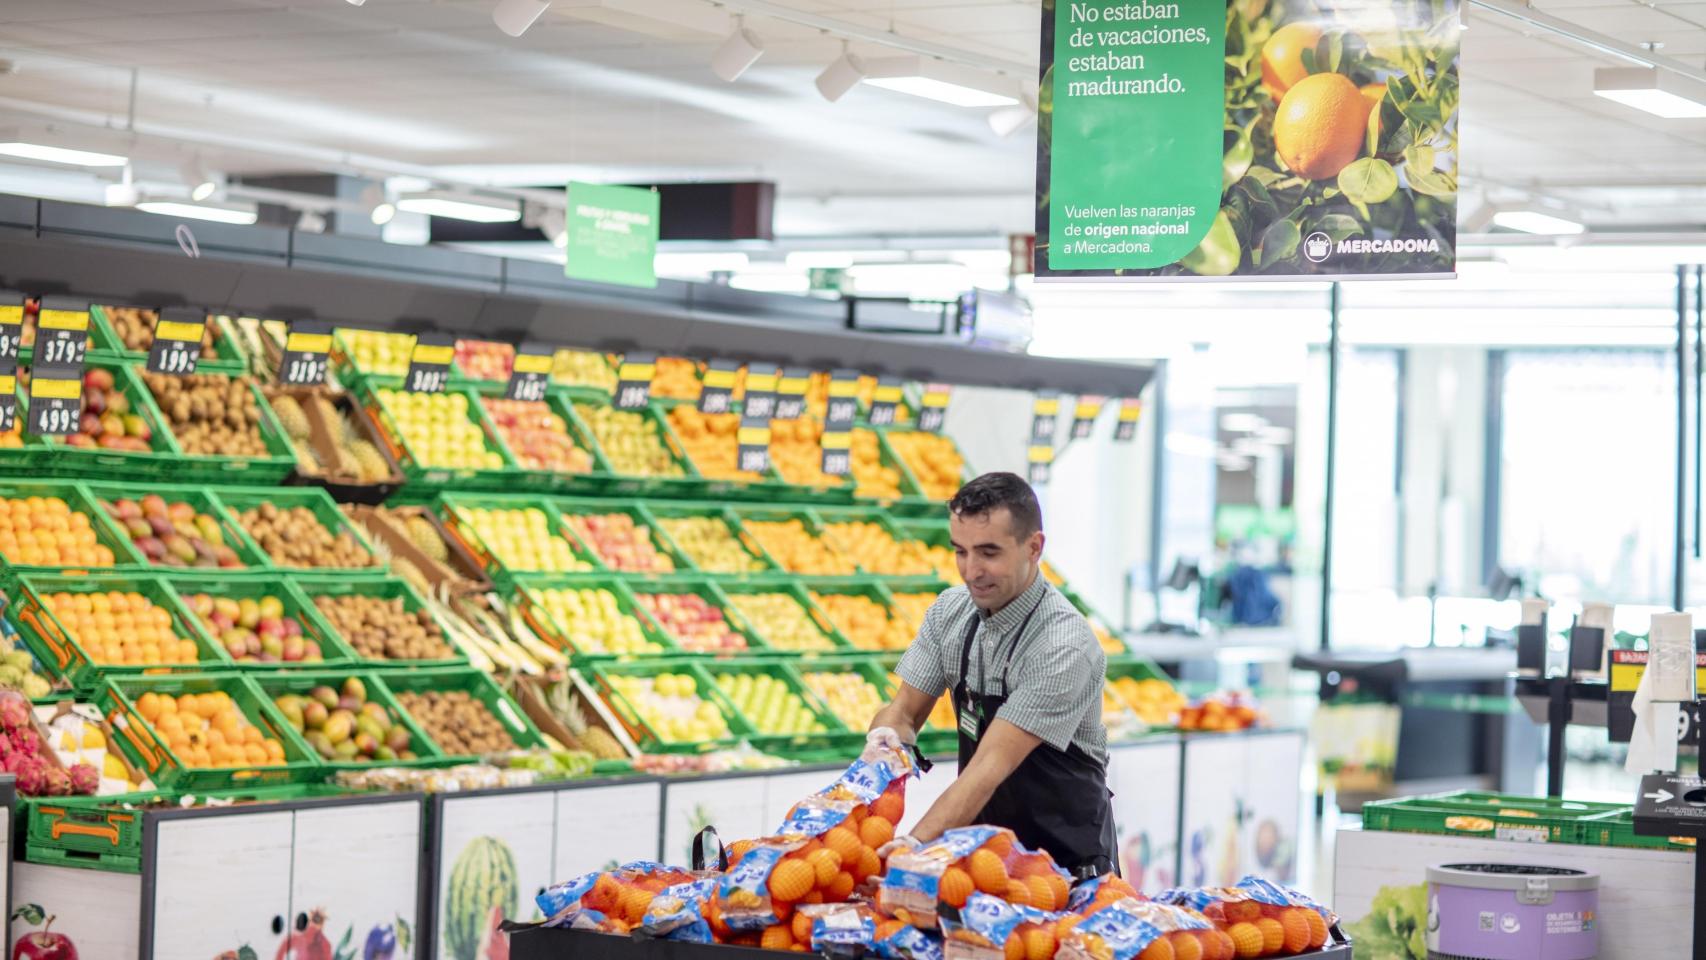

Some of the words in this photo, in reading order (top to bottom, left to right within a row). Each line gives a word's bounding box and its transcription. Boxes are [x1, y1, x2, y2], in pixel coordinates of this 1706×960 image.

[1070, 3, 1099, 23] No
[1103, 0, 1179, 21] estaban
[1069, 28, 1093, 47] de
[1097, 25, 1210, 46] vacaciones,
[1068, 51, 1144, 72] estaban
[1068, 73, 1186, 96] madurando.
[1064, 204, 1117, 218] Vuelven
[1120, 204, 1138, 217] las
[1140, 203, 1196, 219] naranjas
[1064, 223, 1081, 236] de
[1084, 223, 1128, 238] origen
[1131, 221, 1189, 235] nacional
[1063, 244, 1072, 254] a
[1074, 240, 1153, 254] Mercadona.
[1336, 239, 1440, 254] MERCADONA
